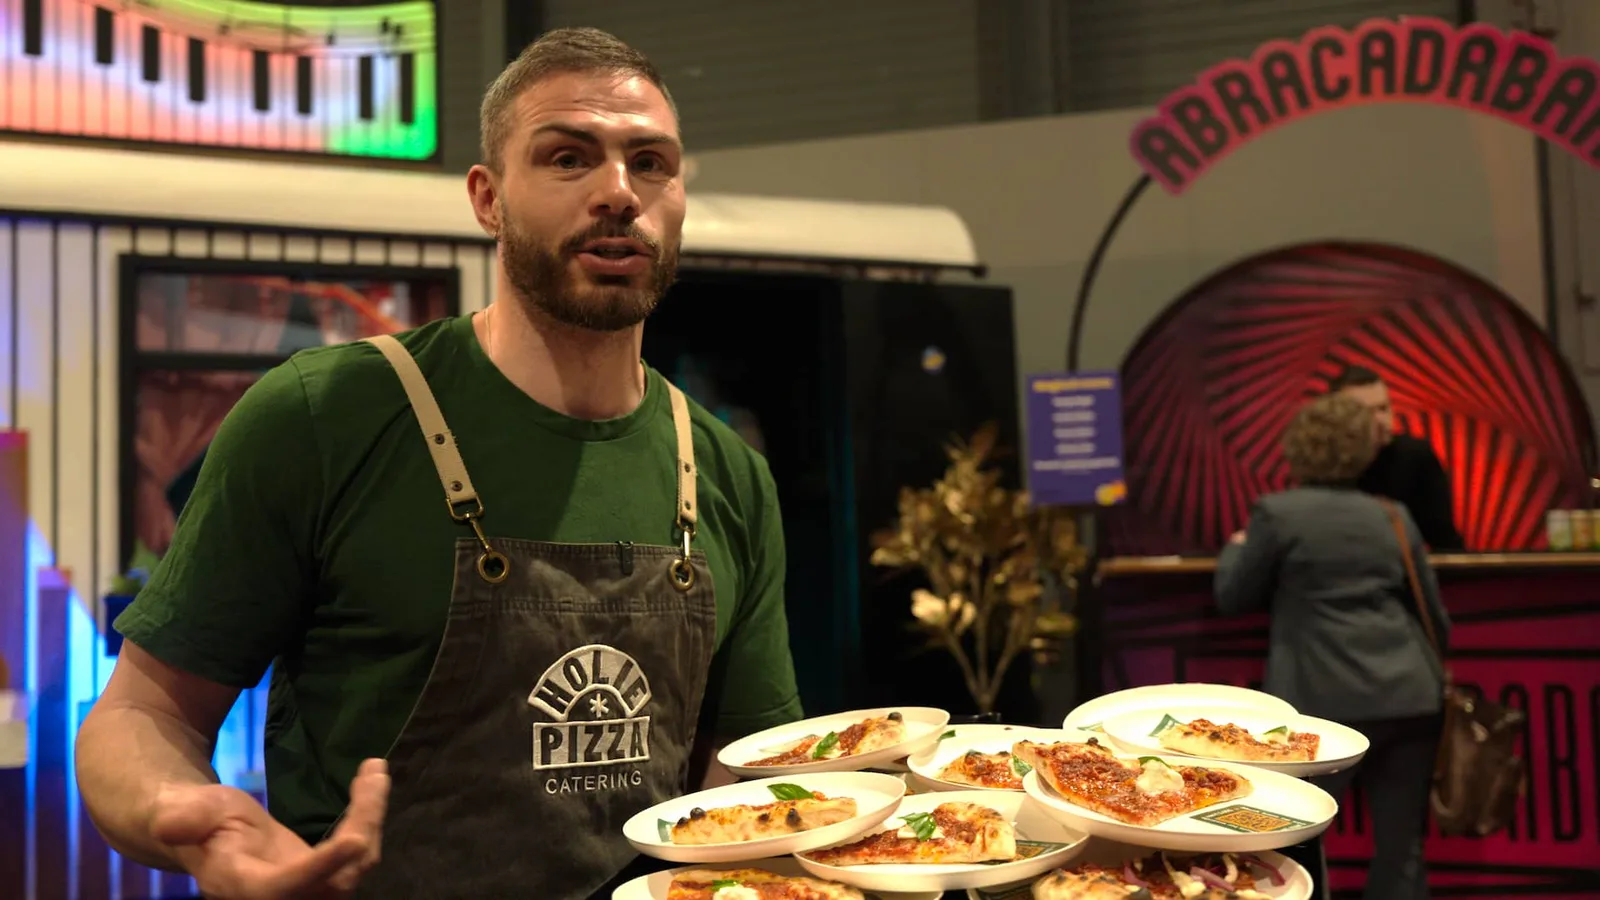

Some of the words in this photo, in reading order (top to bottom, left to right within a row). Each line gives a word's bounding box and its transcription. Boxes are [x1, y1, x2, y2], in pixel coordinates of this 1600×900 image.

[535, 650, 647, 715] HOLIE
[540, 721, 645, 766] PIZZA
[545, 770, 642, 794] CATERING
